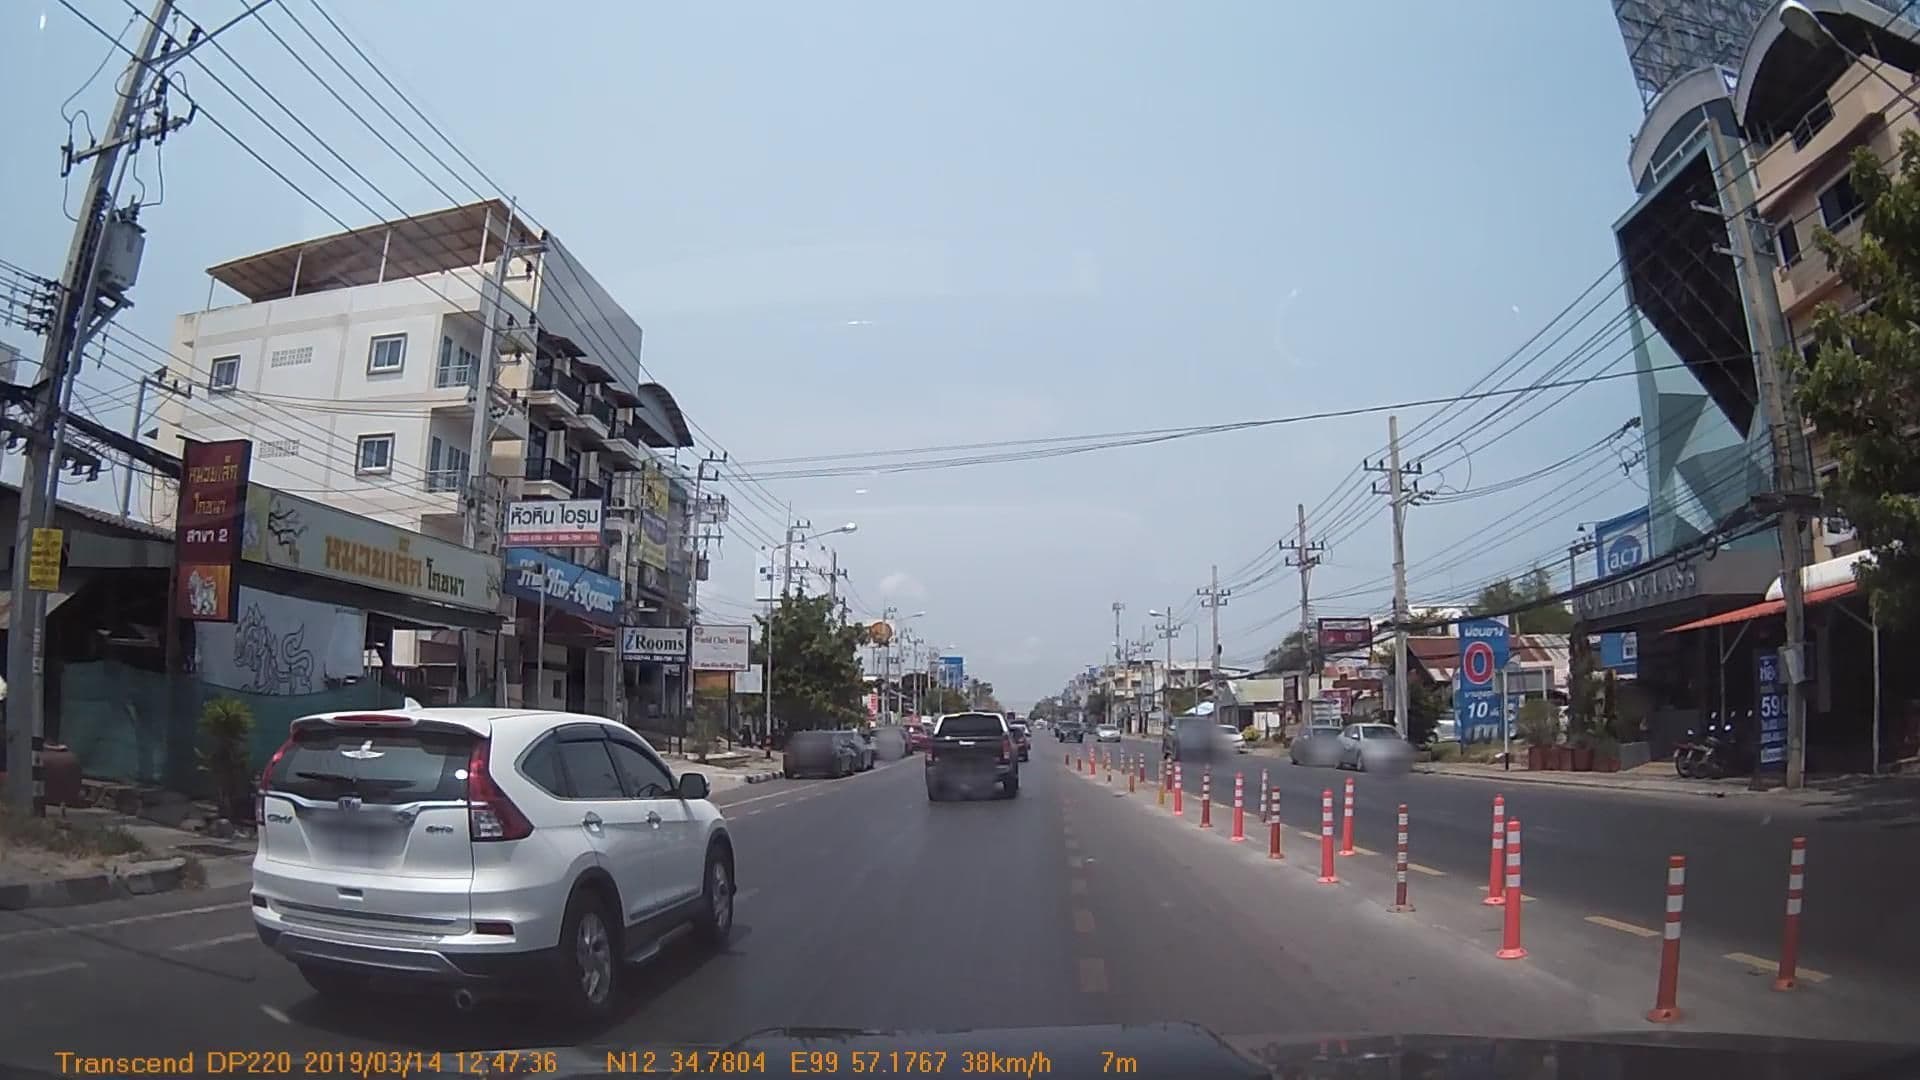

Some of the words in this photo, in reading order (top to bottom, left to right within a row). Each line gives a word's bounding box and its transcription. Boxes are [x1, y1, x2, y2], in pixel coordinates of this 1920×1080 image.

[511, 506, 555, 525] หัวหิน
[559, 503, 598, 529] ไอรูม
[187, 529, 214, 543] สาขา
[218, 528, 228, 542] 2
[1463, 641, 1495, 685] 0
[1468, 702, 1488, 718] 10
